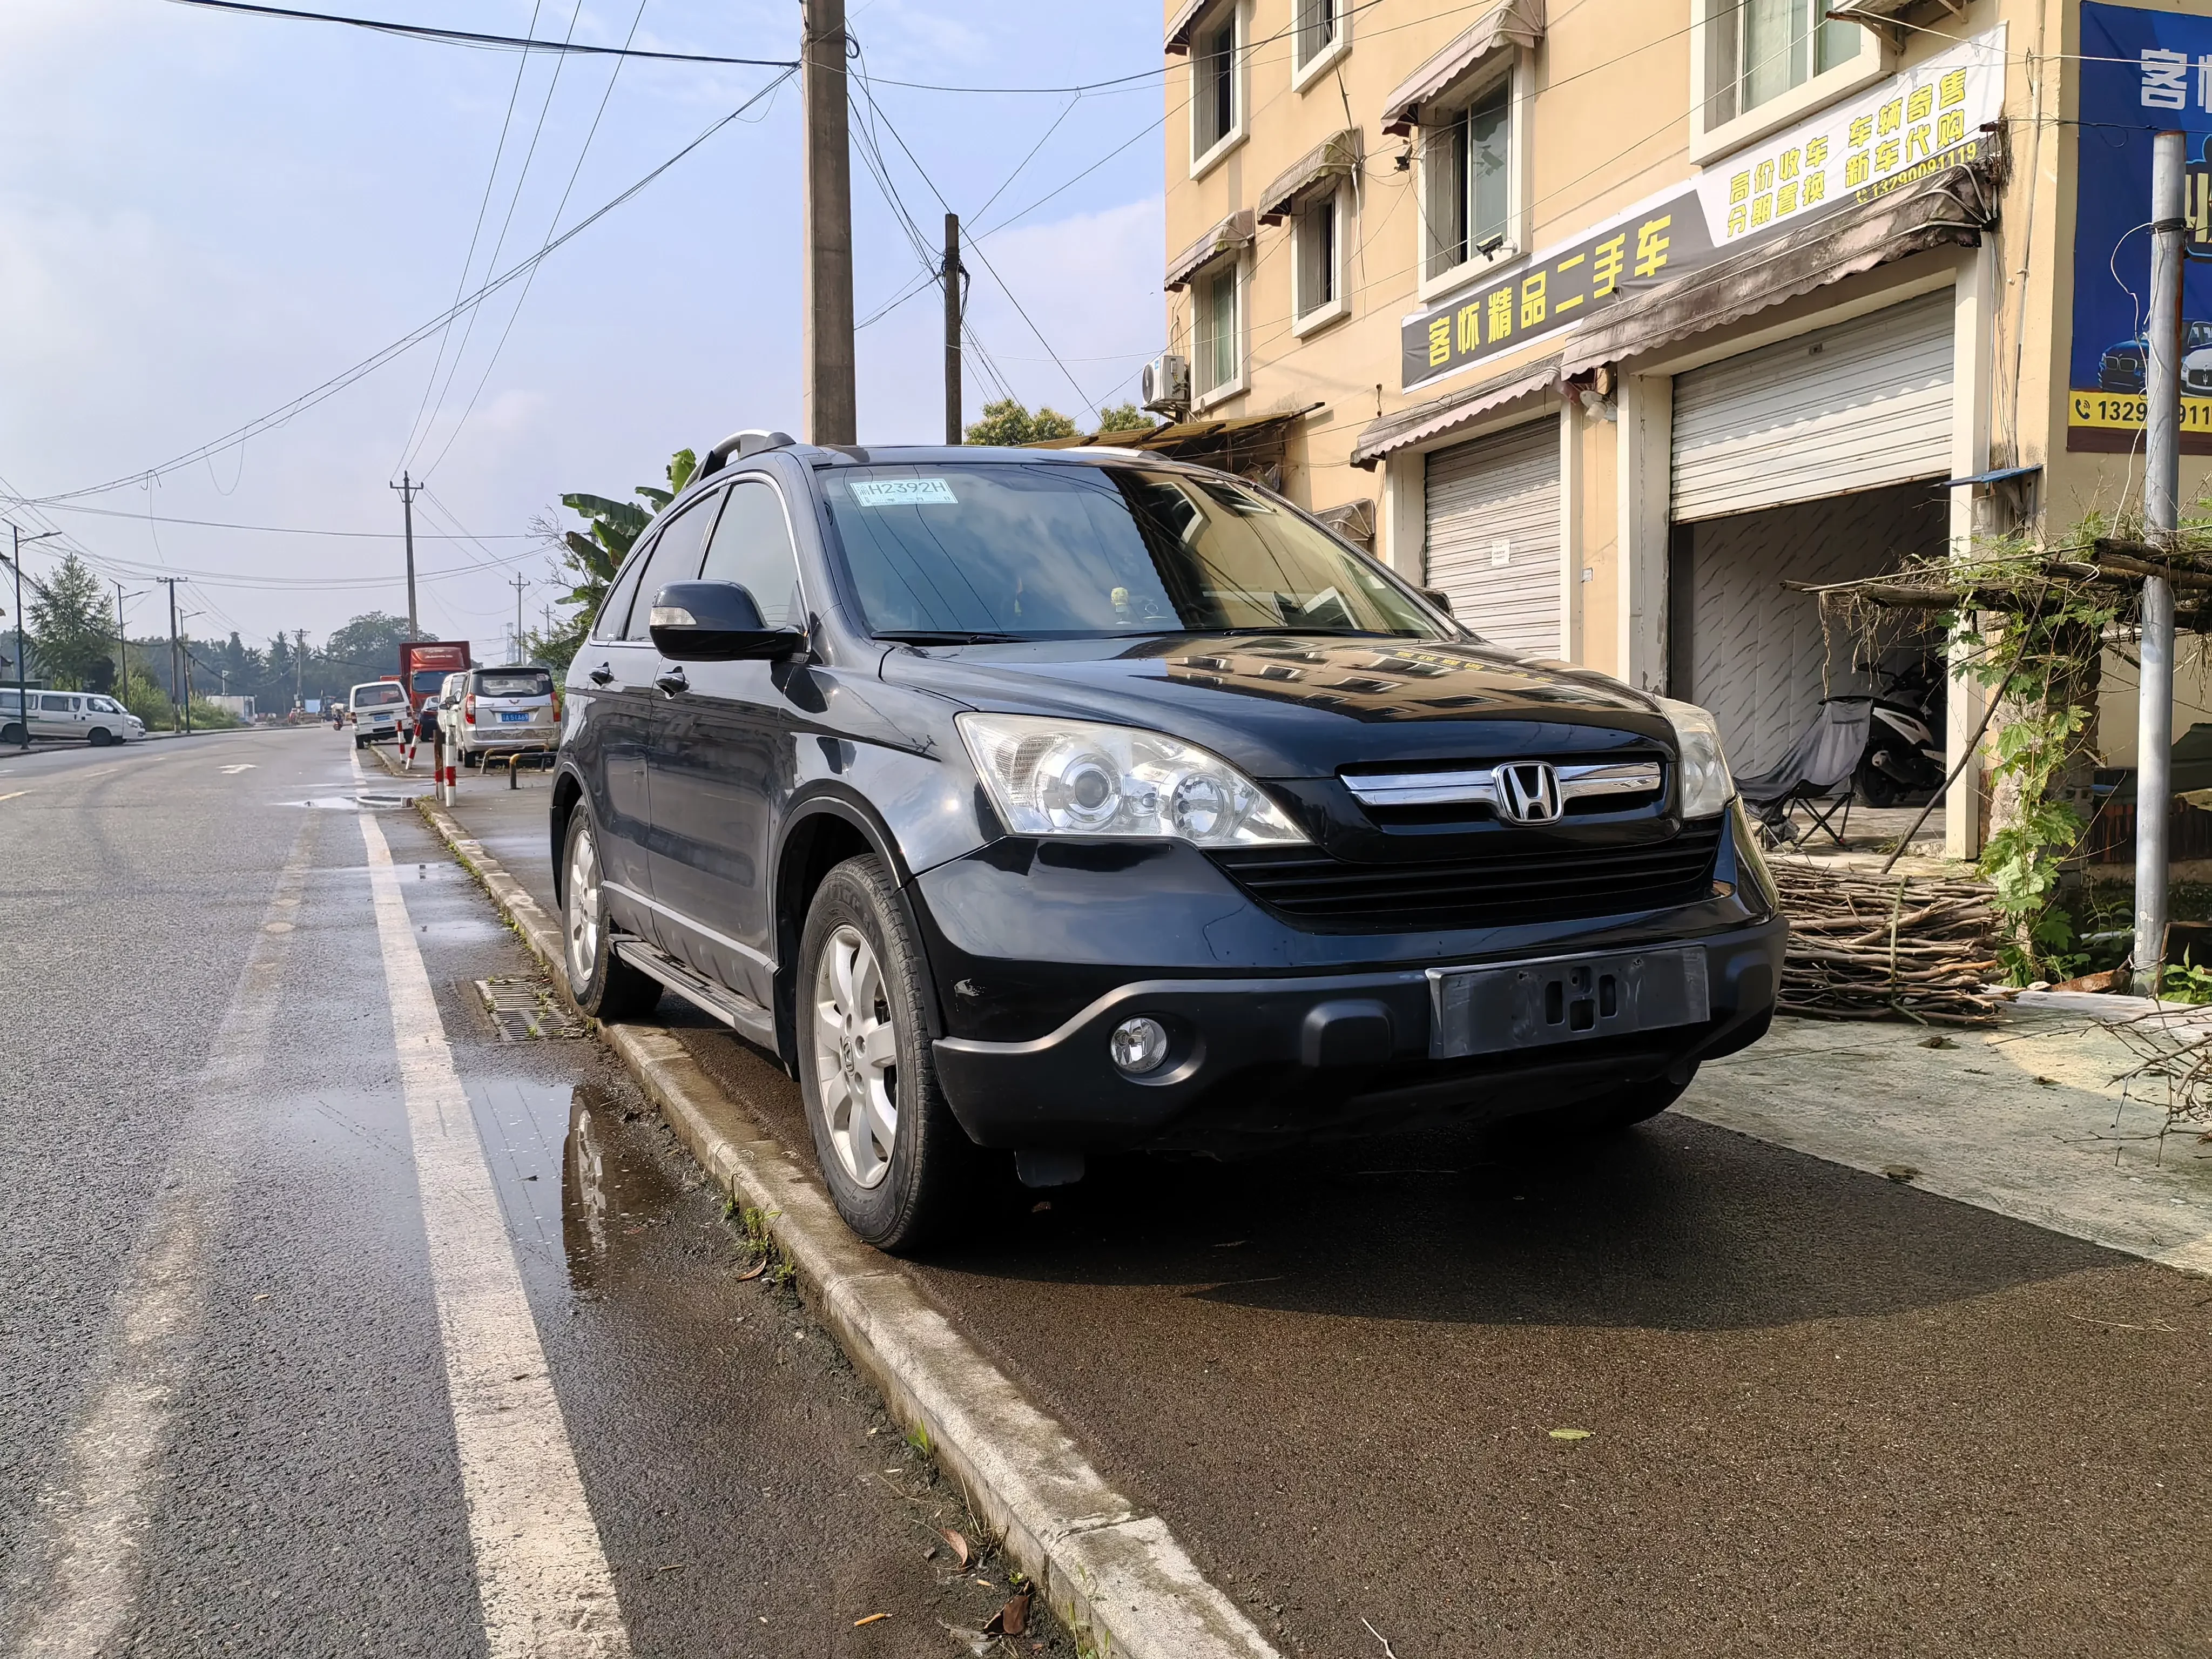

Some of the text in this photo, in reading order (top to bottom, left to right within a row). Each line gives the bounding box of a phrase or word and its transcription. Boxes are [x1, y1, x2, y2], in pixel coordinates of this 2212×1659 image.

[1727, 110, 1965, 238] 分期置换 新车代购
[1730, 68, 1966, 204] 高价收车 车辆寄售
[1872, 141, 1977, 197] 13290091119
[1429, 214, 1671, 367] 客怀精品二手车
